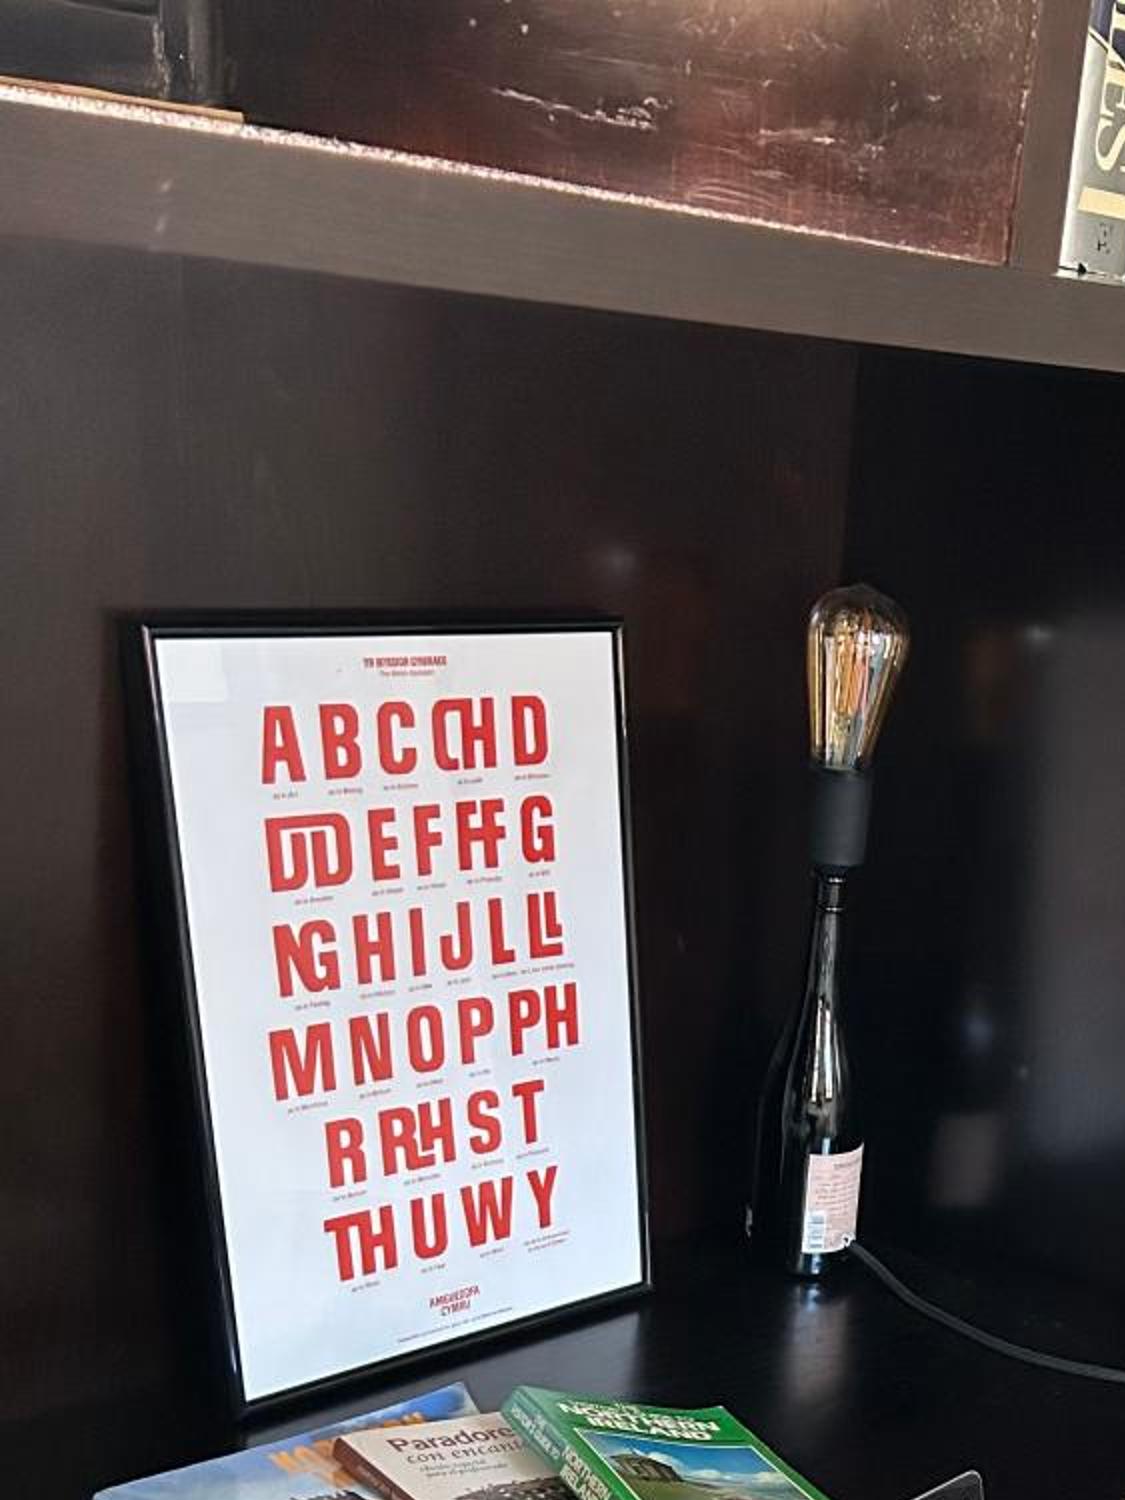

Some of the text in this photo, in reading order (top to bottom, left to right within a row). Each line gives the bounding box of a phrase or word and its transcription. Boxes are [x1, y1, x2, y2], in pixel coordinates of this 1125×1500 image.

[262, 705, 304, 784] A
[319, 704, 362, 780] B
[376, 701, 417, 775] C
[511, 695, 548, 767] D
[367, 807, 400, 881] E
[412, 804, 442, 875] F
[520, 795, 555, 864] G
[352, 912, 395, 984] H
[408, 907, 426, 976] I
[439, 902, 472, 970] J
[487, 897, 516, 965] L
[268, 1023, 336, 1099] M
[349, 1014, 393, 1084] N
[407, 1005, 445, 1072] O
[458, 997, 493, 1064] P
[325, 1119, 366, 1187] R
[467, 1090, 501, 1153] S
[512, 1080, 544, 1143] T
[411, 1193, 448, 1258] U
[461, 1177, 513, 1247] W
[528, 1167, 556, 1227] Y
[386, 1426, 514, 1453] Paradore
[406, 1453, 446, 1465] con
[556, 1403, 721, 1432] NORTHERN
[586, 1417, 712, 1441] IRELAND
